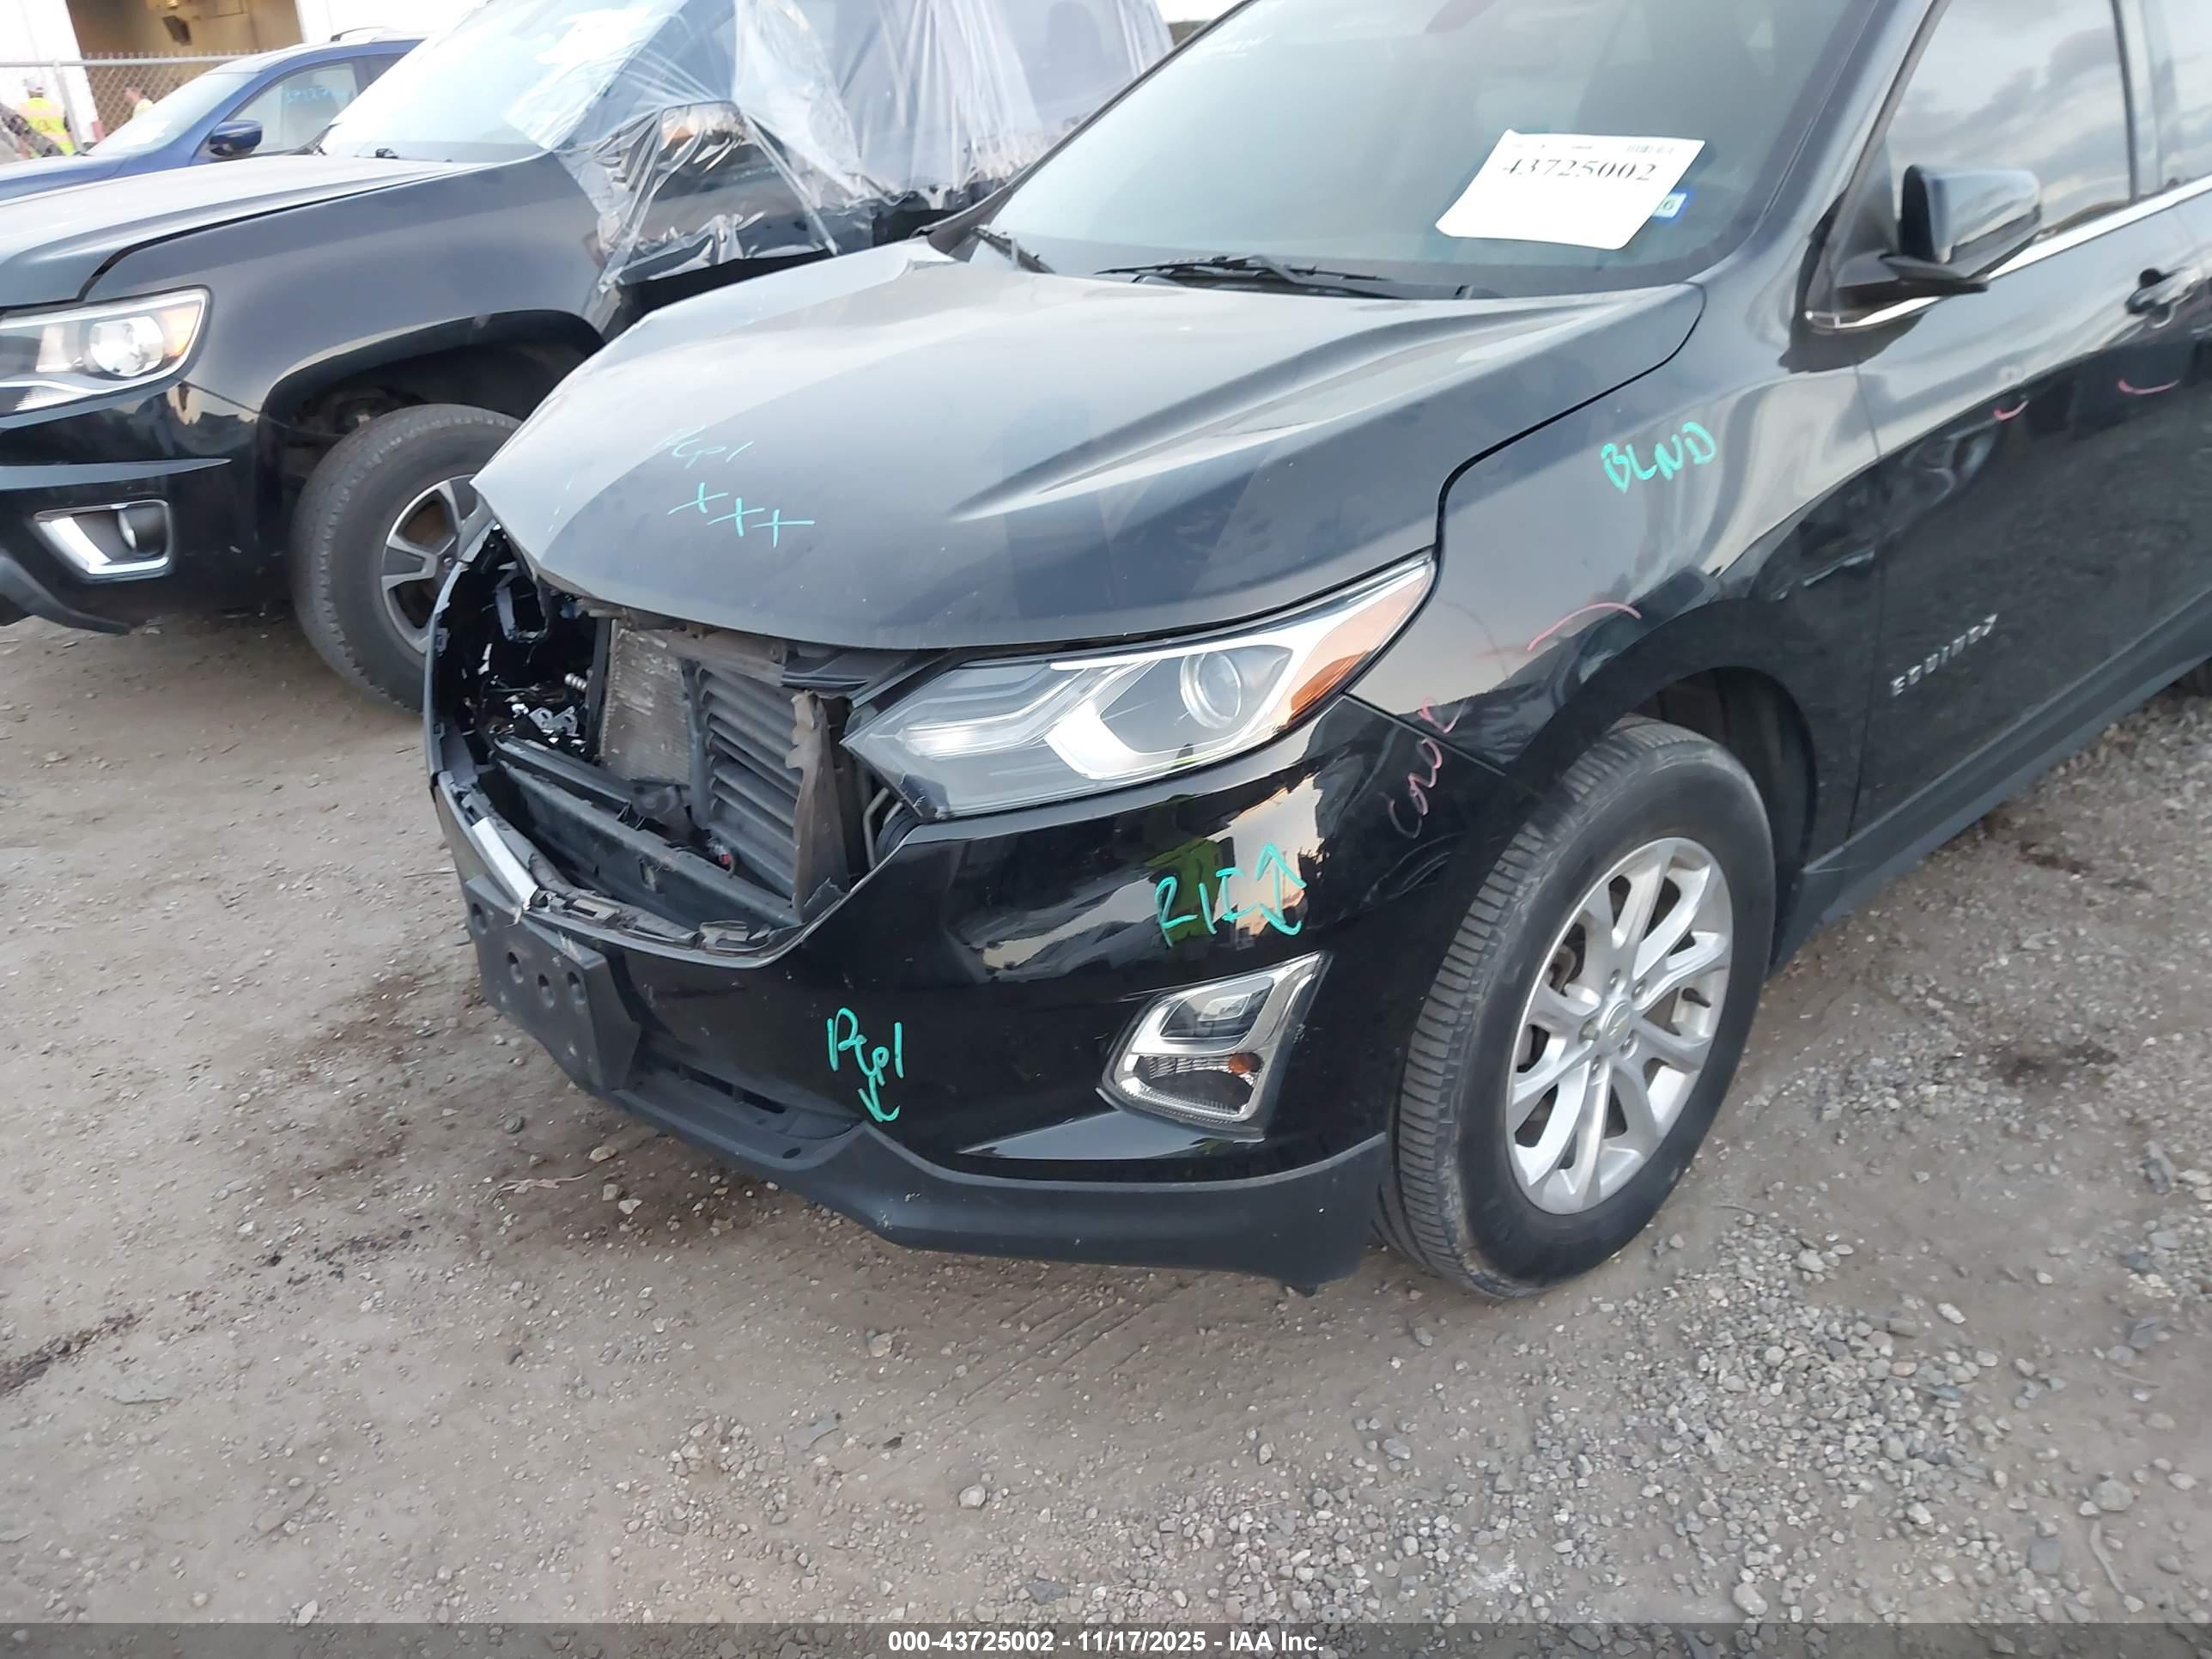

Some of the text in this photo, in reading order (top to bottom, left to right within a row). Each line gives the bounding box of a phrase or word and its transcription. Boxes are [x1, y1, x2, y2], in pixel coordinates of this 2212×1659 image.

[1502, 158, 1657, 181] 43725002
[1601, 421, 1717, 495] BLND
[1890, 613, 1999, 697] EQUINOX
